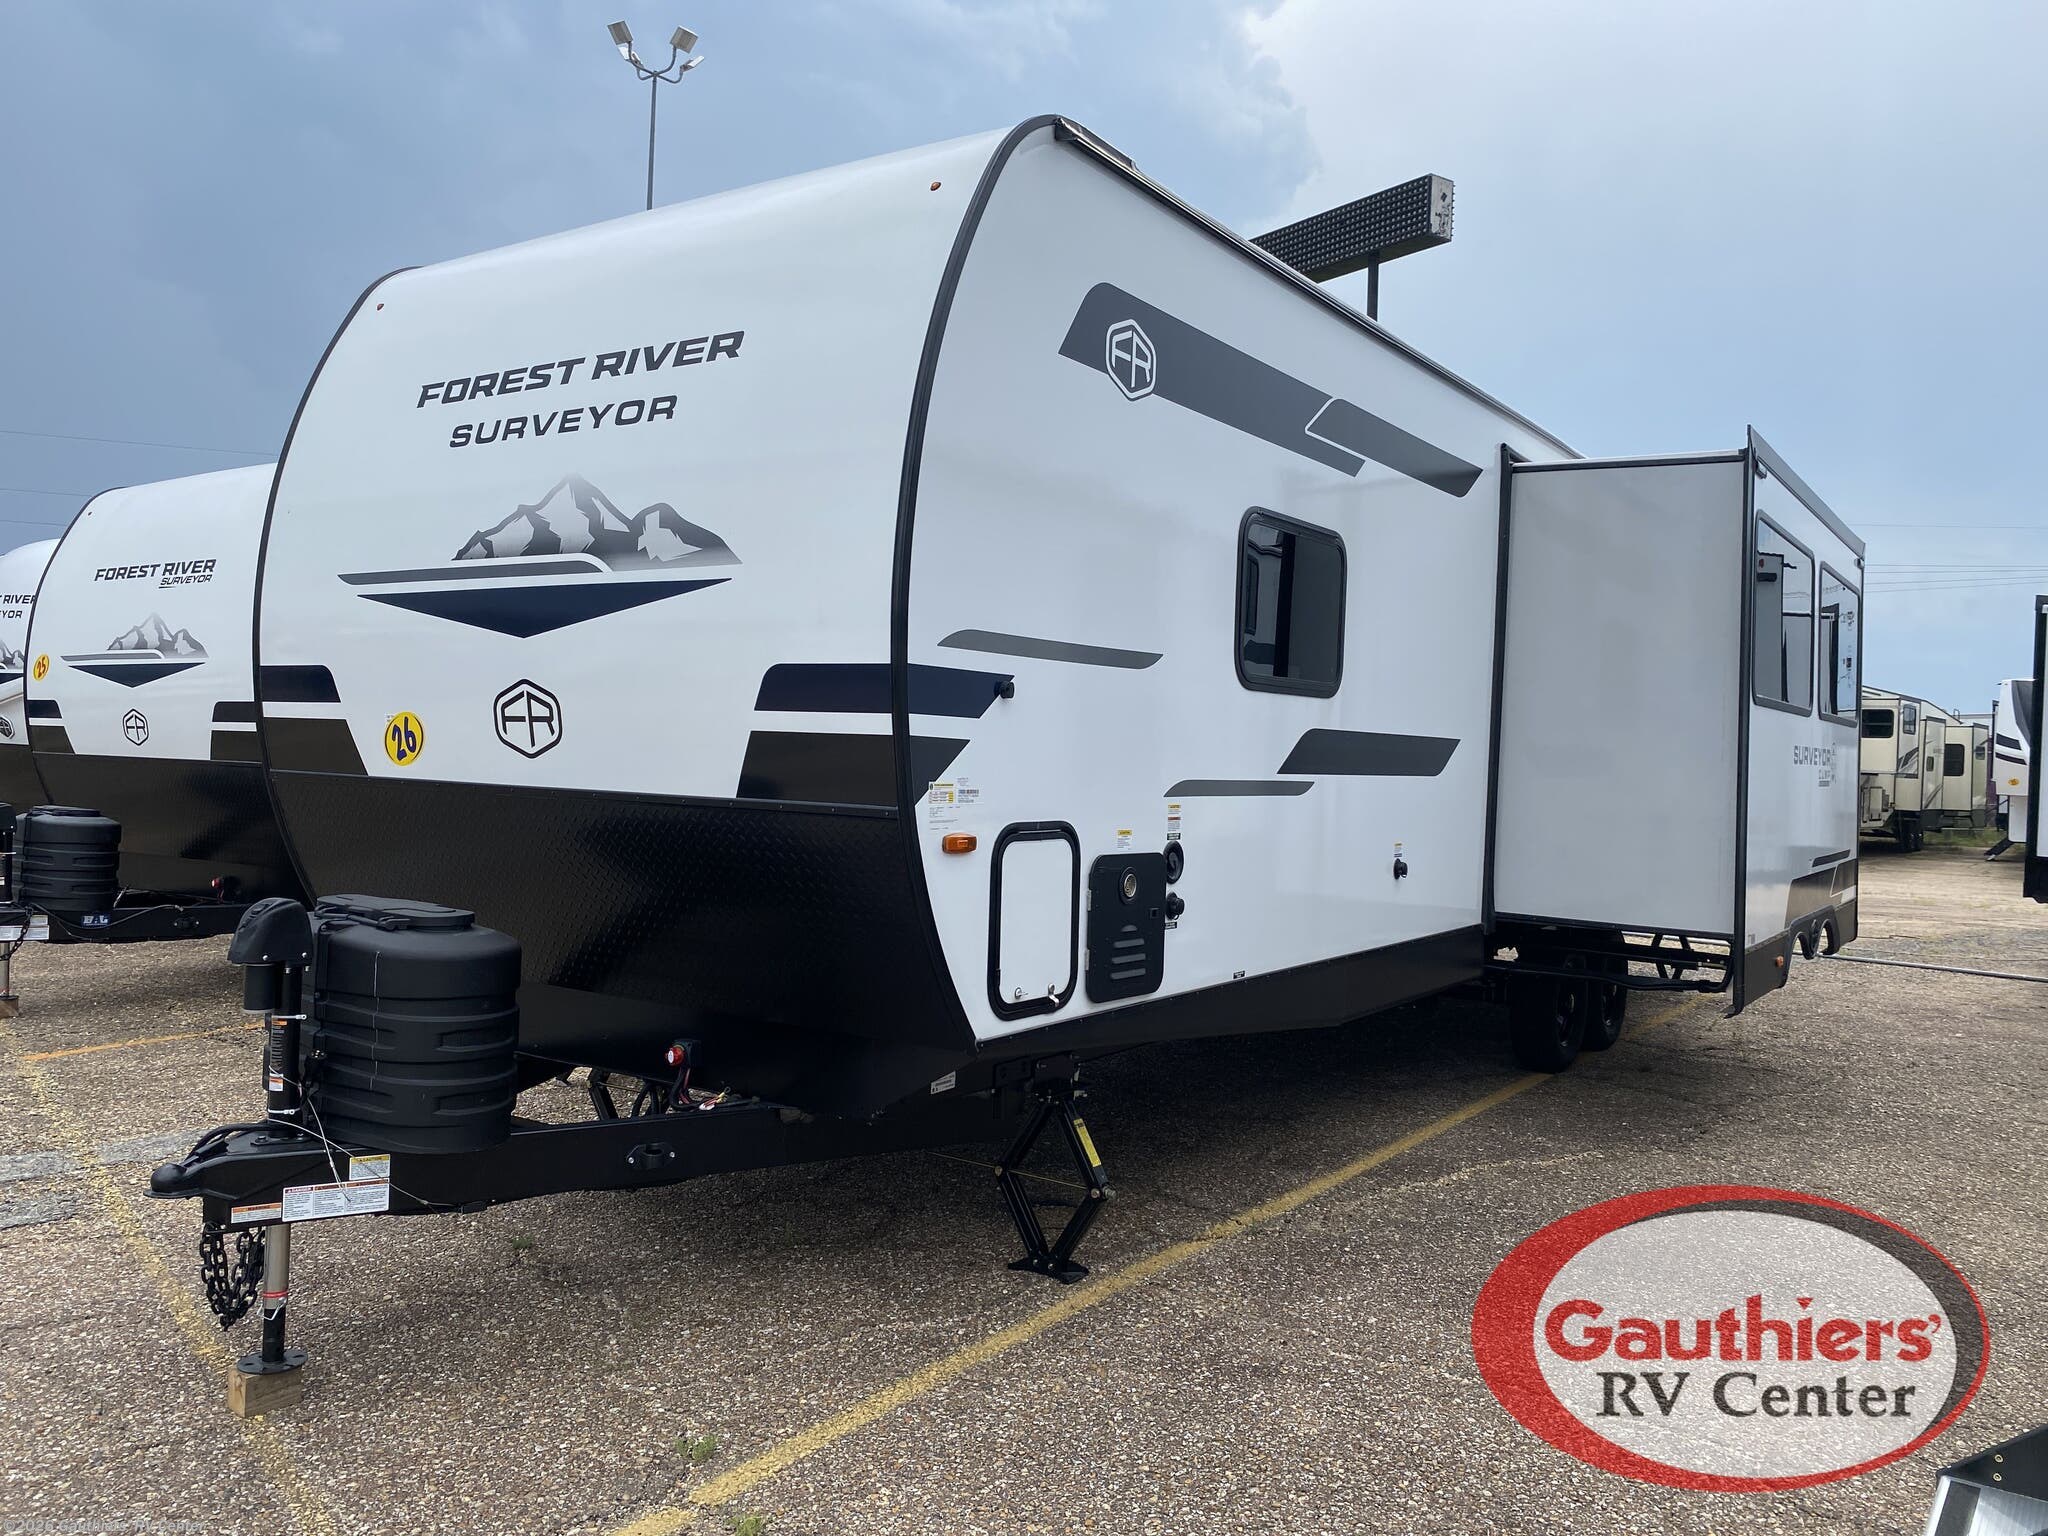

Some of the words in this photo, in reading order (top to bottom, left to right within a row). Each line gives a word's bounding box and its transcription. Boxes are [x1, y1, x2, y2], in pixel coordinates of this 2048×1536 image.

[416, 356, 586, 408] FOREST
[590, 330, 745, 380] RIVER
[449, 394, 678, 448] SURVEYOR
[94, 563, 161, 581] FOREST
[162, 559, 217, 576] RIVER
[160, 574, 213, 586] SURVEYOR
[37, 656, 46, 678] 25
[392, 716, 417, 762] 26
[1793, 745, 1831, 767] SURVEYOR
